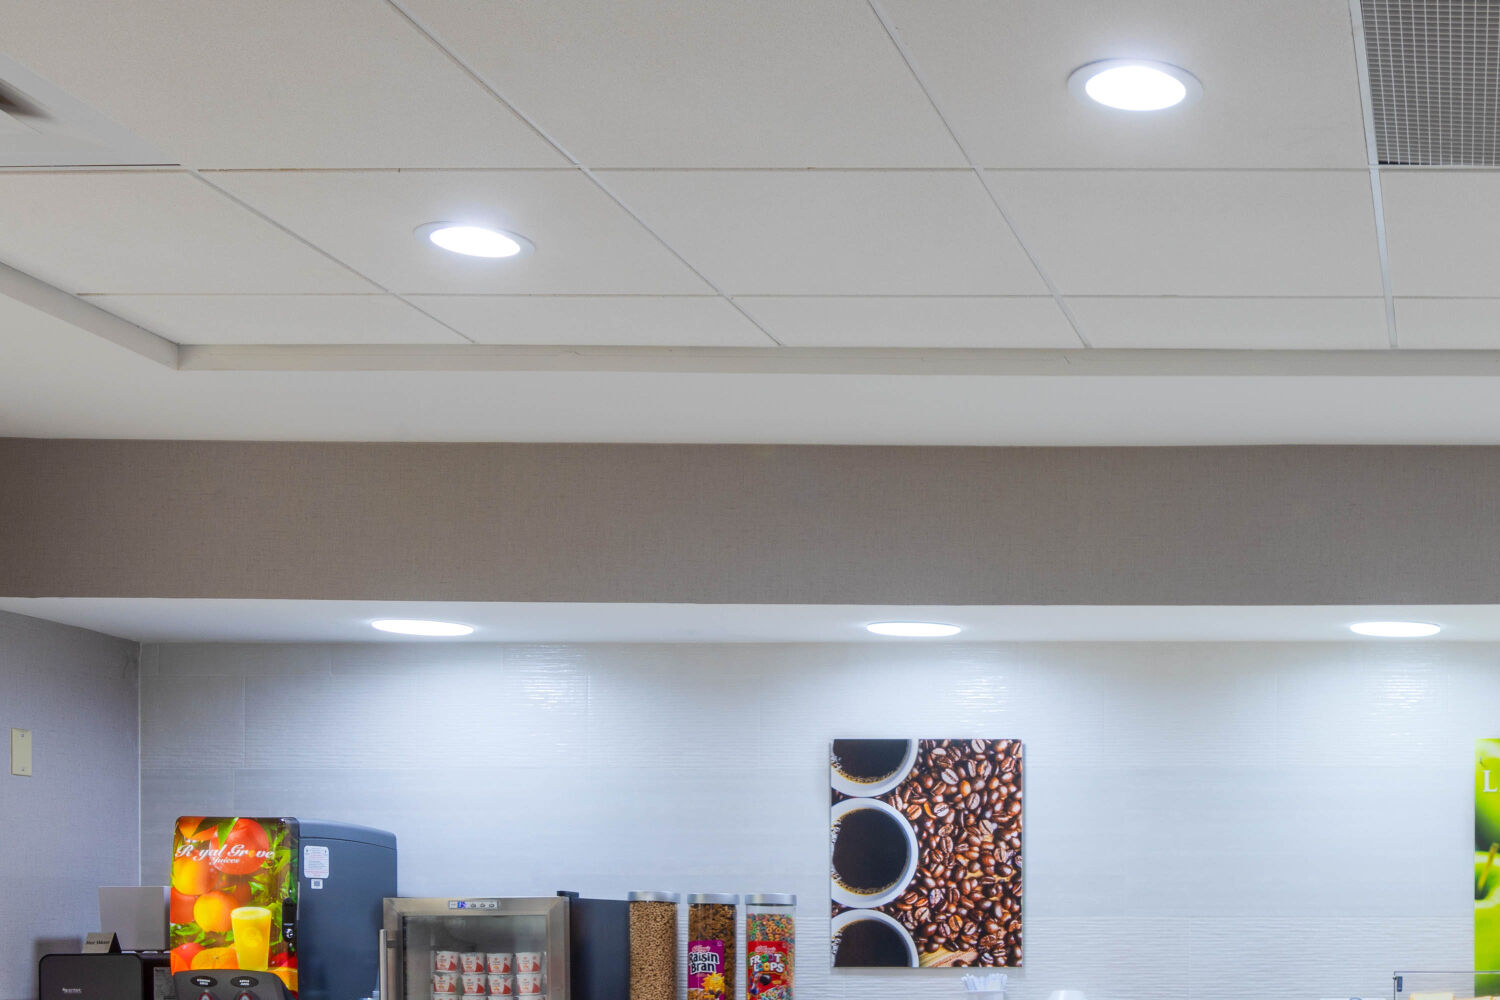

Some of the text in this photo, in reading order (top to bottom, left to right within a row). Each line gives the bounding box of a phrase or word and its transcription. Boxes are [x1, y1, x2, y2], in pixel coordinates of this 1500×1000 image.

[750, 953, 782, 966] FROOT
[690, 961, 716, 975] Bran
[754, 962, 785, 973] LOOPS
